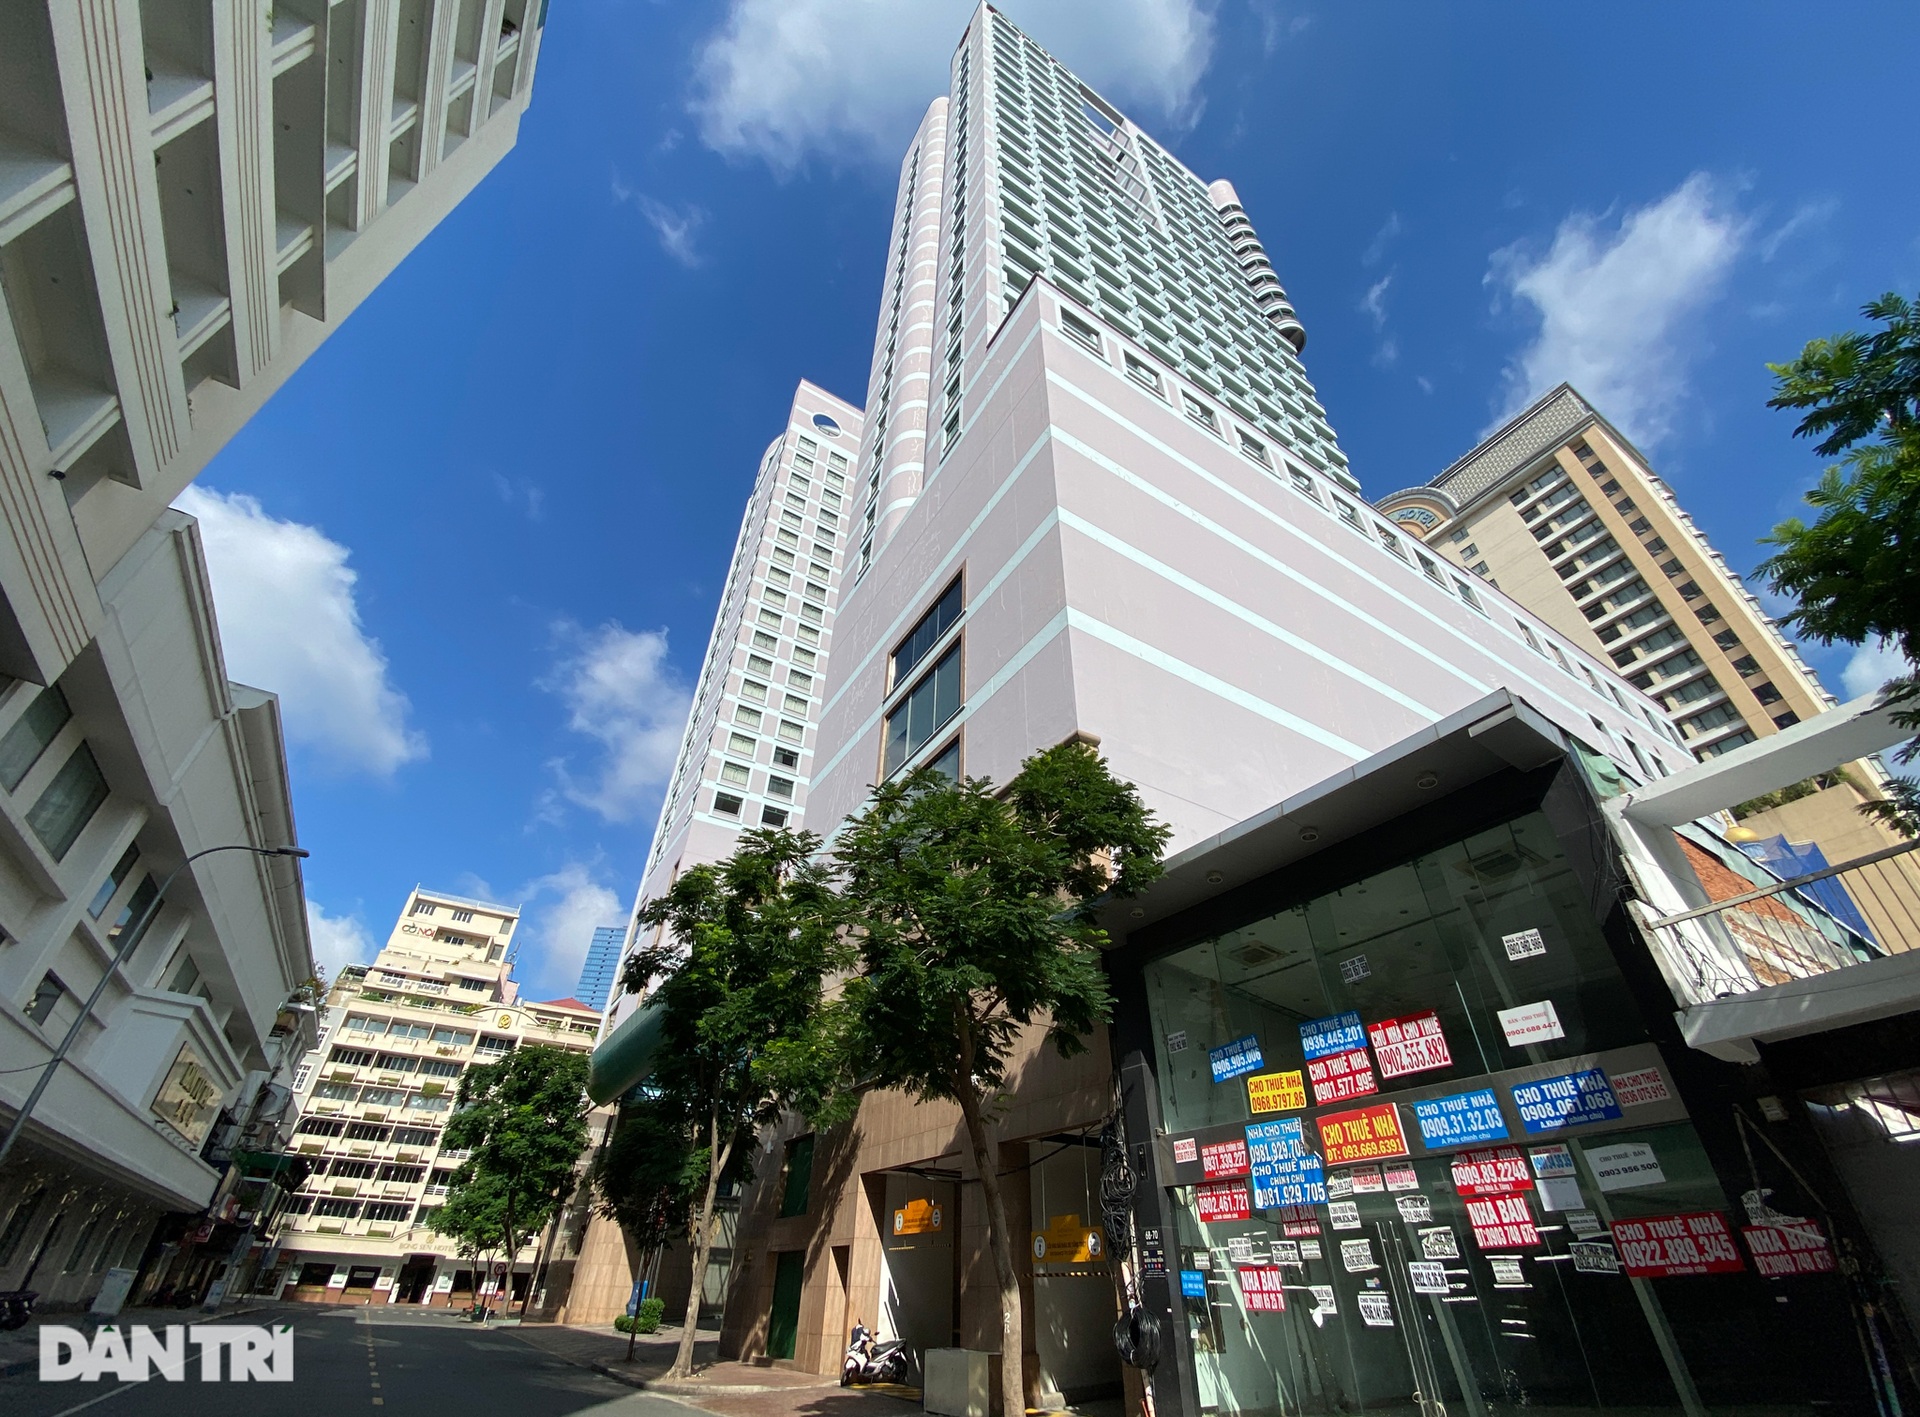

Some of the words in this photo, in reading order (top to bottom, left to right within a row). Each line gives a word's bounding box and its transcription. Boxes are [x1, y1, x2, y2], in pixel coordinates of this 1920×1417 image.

[1398, 510, 1435, 528] HOTEL
[1300, 1024, 1317, 1037] CHO
[1318, 1016, 1340, 1033] THUÊ
[1341, 1011, 1360, 1027] NHÀ
[1370, 1023, 1386, 1048] CHỦ
[1386, 1021, 1403, 1044] NHÀ
[1402, 1021, 1419, 1039] CHO
[1418, 1012, 1441, 1035] THUÊ
[1210, 1050, 1224, 1062] CHO
[1225, 1041, 1242, 1057] THUÊ
[1243, 1036, 1258, 1050] NHÀ
[1302, 1024, 1363, 1052] 0936.445.201
[1212, 1048, 1262, 1075] 0906.905.006
[1309, 1062, 1327, 1081] CHO
[1326, 1053, 1350, 1076] THUÊ
[1348, 1048, 1370, 1071] NHÀ
[1378, 1037, 1449, 1075] 0902.555.882
[1249, 1080, 1264, 1093] CHO
[1265, 1074, 1284, 1091] THUÊ
[1286, 1072, 1302, 1088] NHÀ
[1314, 1071, 1374, 1102] 0901.577.995
[1514, 1086, 1540, 1105] CHO
[1541, 1076, 1578, 1100] THUÊ
[1577, 1070, 1608, 1093] NHÀ
[1612, 1076, 1629, 1090] NHÀ
[1629, 1074, 1642, 1088] CHO
[1642, 1069, 1662, 1085] THUÊ
[1252, 1091, 1305, 1111] 0968.9797.86
[1417, 1103, 1439, 1117] CHO
[1440, 1096, 1469, 1112] THUÊ
[1470, 1092, 1495, 1108] NHÀ
[1520, 1091, 1615, 1121] 0908.061.068
[1618, 1090, 1637, 1104] 0936
[1637, 1087, 1652, 1101] 075
[1652, 1084, 1667, 1097] 915
[1247, 1124, 1264, 1139] NHÀ
[1264, 1125, 1280, 1136] CHO
[1280, 1118, 1300, 1133] THUÊ
[1322, 1123, 1343, 1146] CHO
[1342, 1113, 1372, 1142] THUÊ
[1372, 1108, 1398, 1138] NHÀ
[1421, 1108, 1503, 1138] 0909.31.32.03
[1203, 1150, 1246, 1171] 0931.339.227
[1342, 1138, 1403, 1159] 093.669.6391
[1469, 1149, 1496, 1164] THUÊ
[1497, 1146, 1522, 1160] NHÀ
[1253, 1165, 1272, 1177] CHO
[1274, 1159, 1297, 1173] THUÊ
[1299, 1156, 1320, 1170] NHÀ
[1452, 1161, 1529, 1186] 0909.89.2248
[1599, 1168, 1621, 1177] 0903
[1622, 1165, 1639, 1174] 956
[1641, 1162, 1658, 1170] 500
[1197, 1186, 1211, 1197] CHO
[1212, 1181, 1230, 1194] THUÊ
[1230, 1179, 1246, 1192] NHÀ
[1256, 1182, 1325, 1207] 0981.929.705
[1199, 1194, 1249, 1214] 0902.461.721
[1466, 1197, 1500, 1226] NHÀ
[1496, 1194, 1530, 1223] BÁN
[1145, 1230, 1158, 1240] 68-70
[1504, 1225, 1522, 1244] 748
[1520, 1223, 1537, 1243] 675
[1614, 1224, 1646, 1241] CHO
[1645, 1216, 1688, 1238] THUÊ
[1687, 1212, 1725, 1234] NHÀ
[1621, 1234, 1737, 1268] 0922.889.345
[1240, 1267, 1260, 1291] NHÀ
[1260, 1267, 1280, 1291] BÁN
